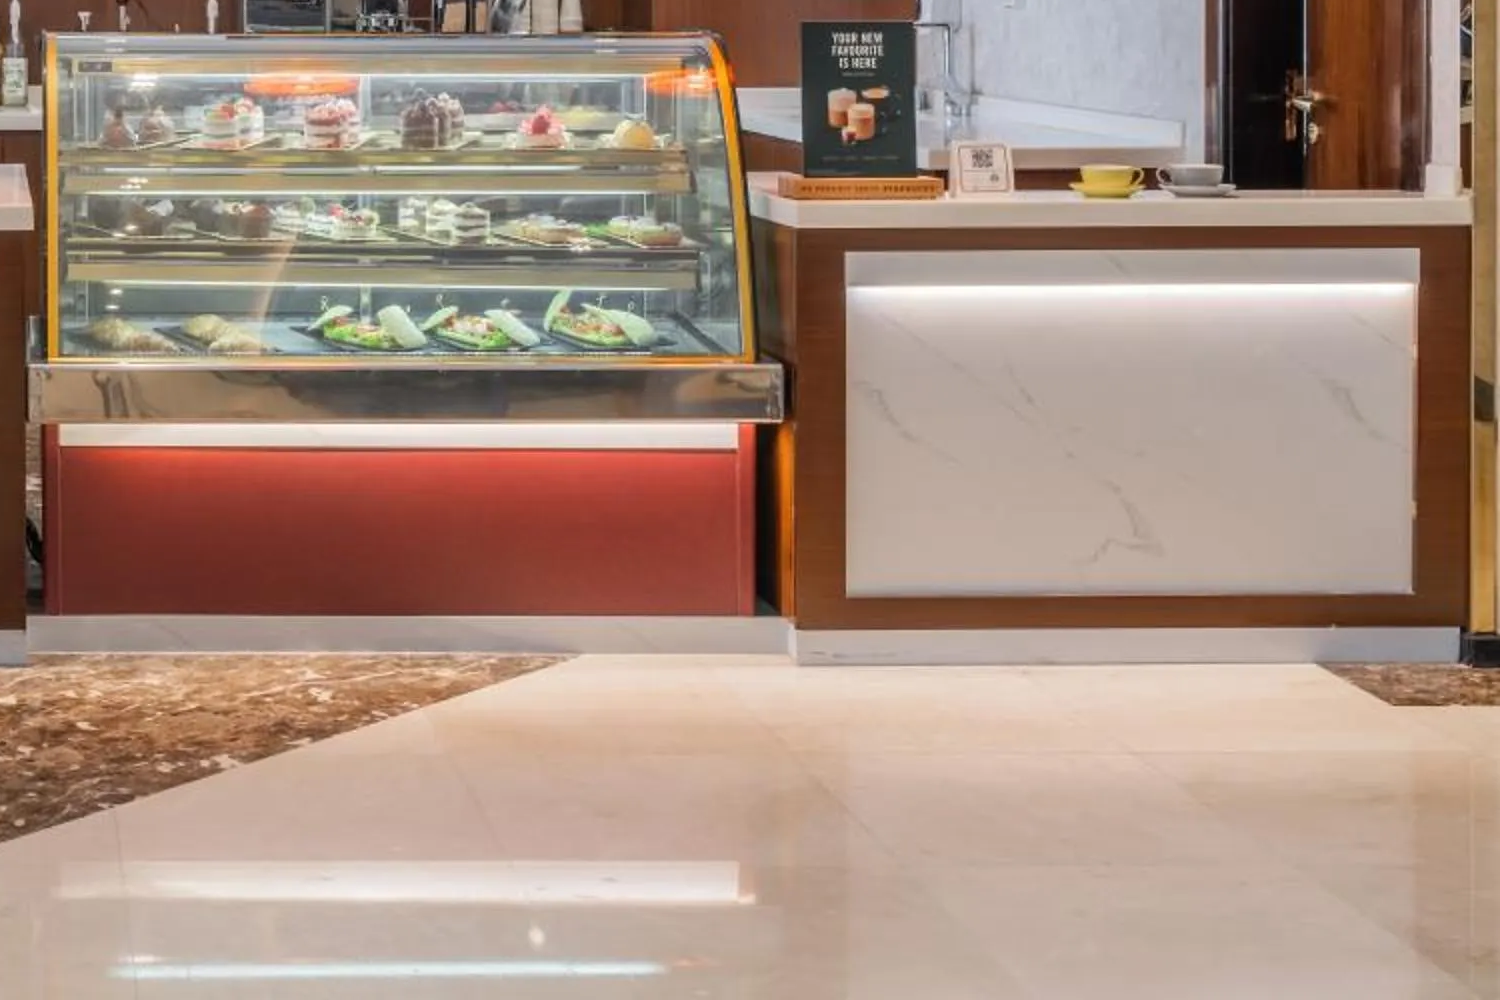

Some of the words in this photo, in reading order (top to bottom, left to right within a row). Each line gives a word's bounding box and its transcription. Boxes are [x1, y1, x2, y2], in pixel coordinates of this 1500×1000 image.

[831, 31, 859, 44] YOUR
[861, 31, 884, 44] NEW
[831, 45, 884, 57] FAVOURITE
[839, 57, 850, 69] IS
[851, 57, 877, 69] HERE
